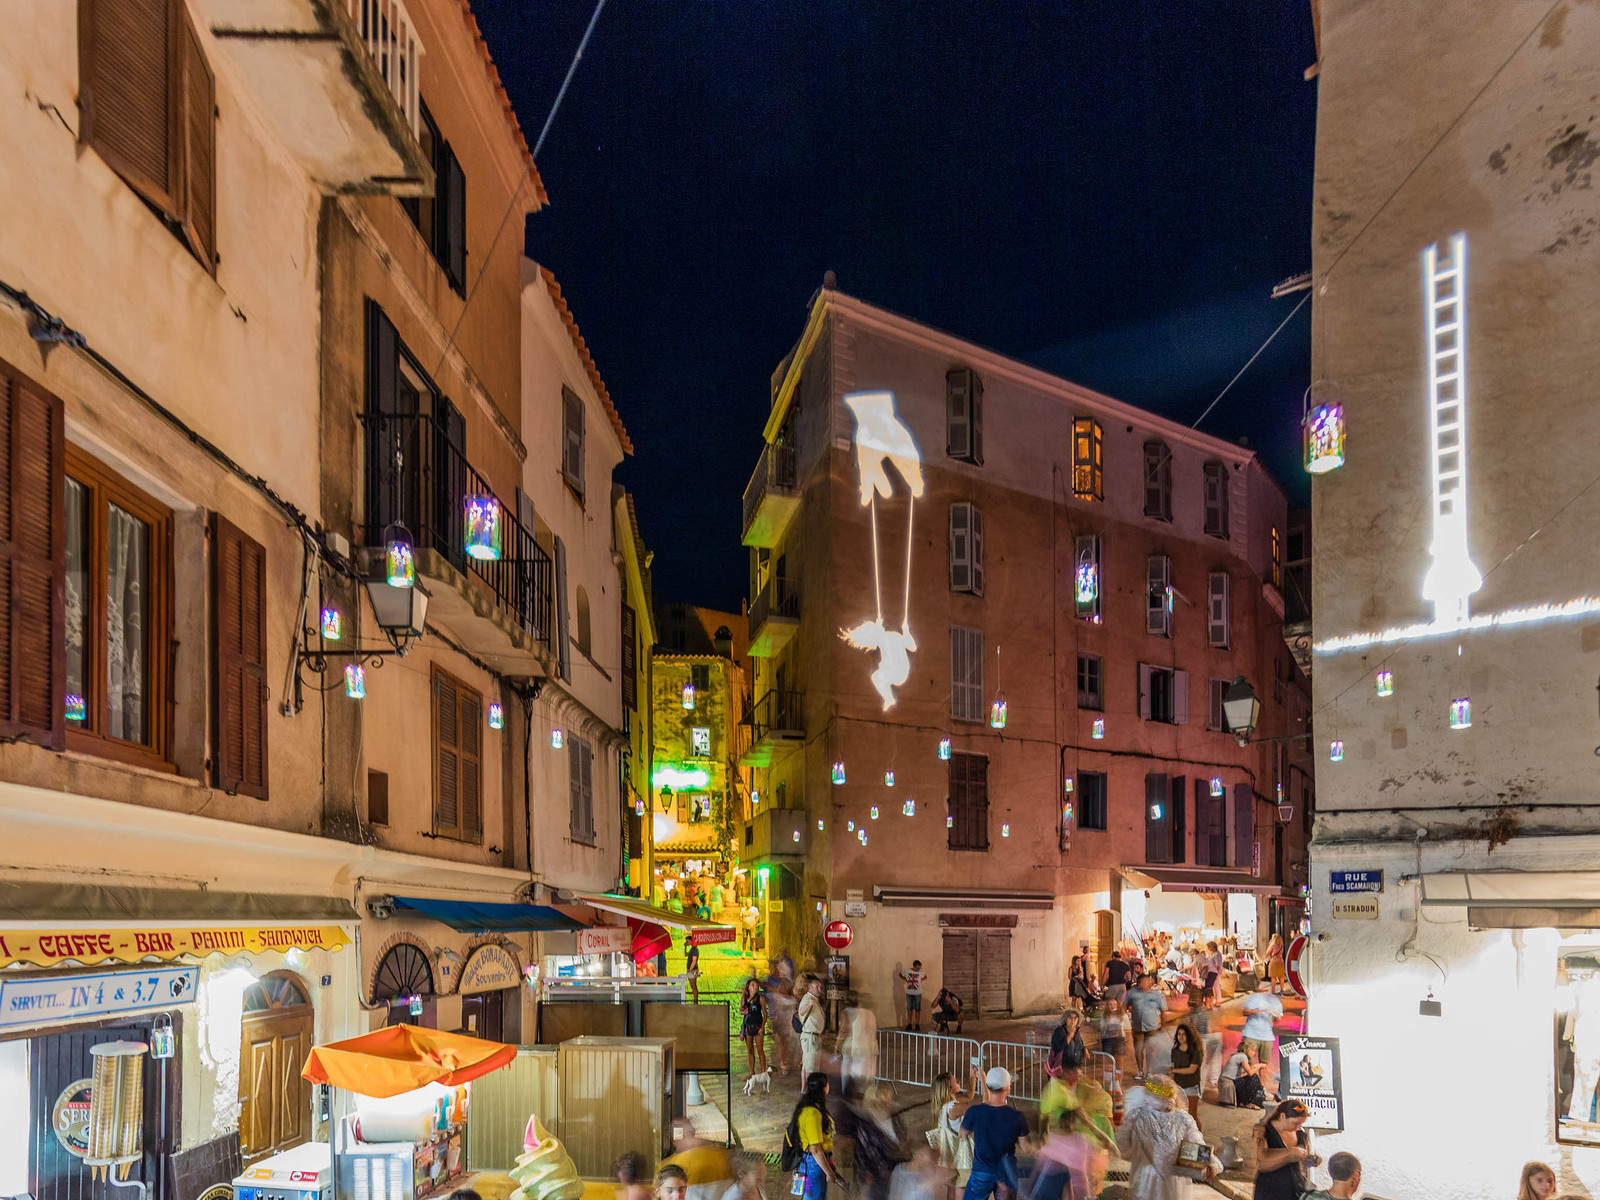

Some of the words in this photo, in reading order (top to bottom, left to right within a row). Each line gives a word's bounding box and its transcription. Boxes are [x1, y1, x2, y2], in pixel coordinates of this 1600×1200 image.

[1345, 873, 1367, 881] RUE
[1346, 882, 1380, 890] SCAMARONI
[39, 934, 114, 958] CAFFE
[134, 932, 175, 953] BAR
[191, 931, 245, 950] PANINI
[258, 929, 323, 947] SANDWICH
[587, 933, 610, 949] CORAIL
[69, 985, 91, 1008] IN
[94, 981, 104, 1005] 4
[114, 987, 125, 1000] &
[132, 977, 160, 1003] 3.7
[1289, 1097, 1336, 1109] NIFACIO
